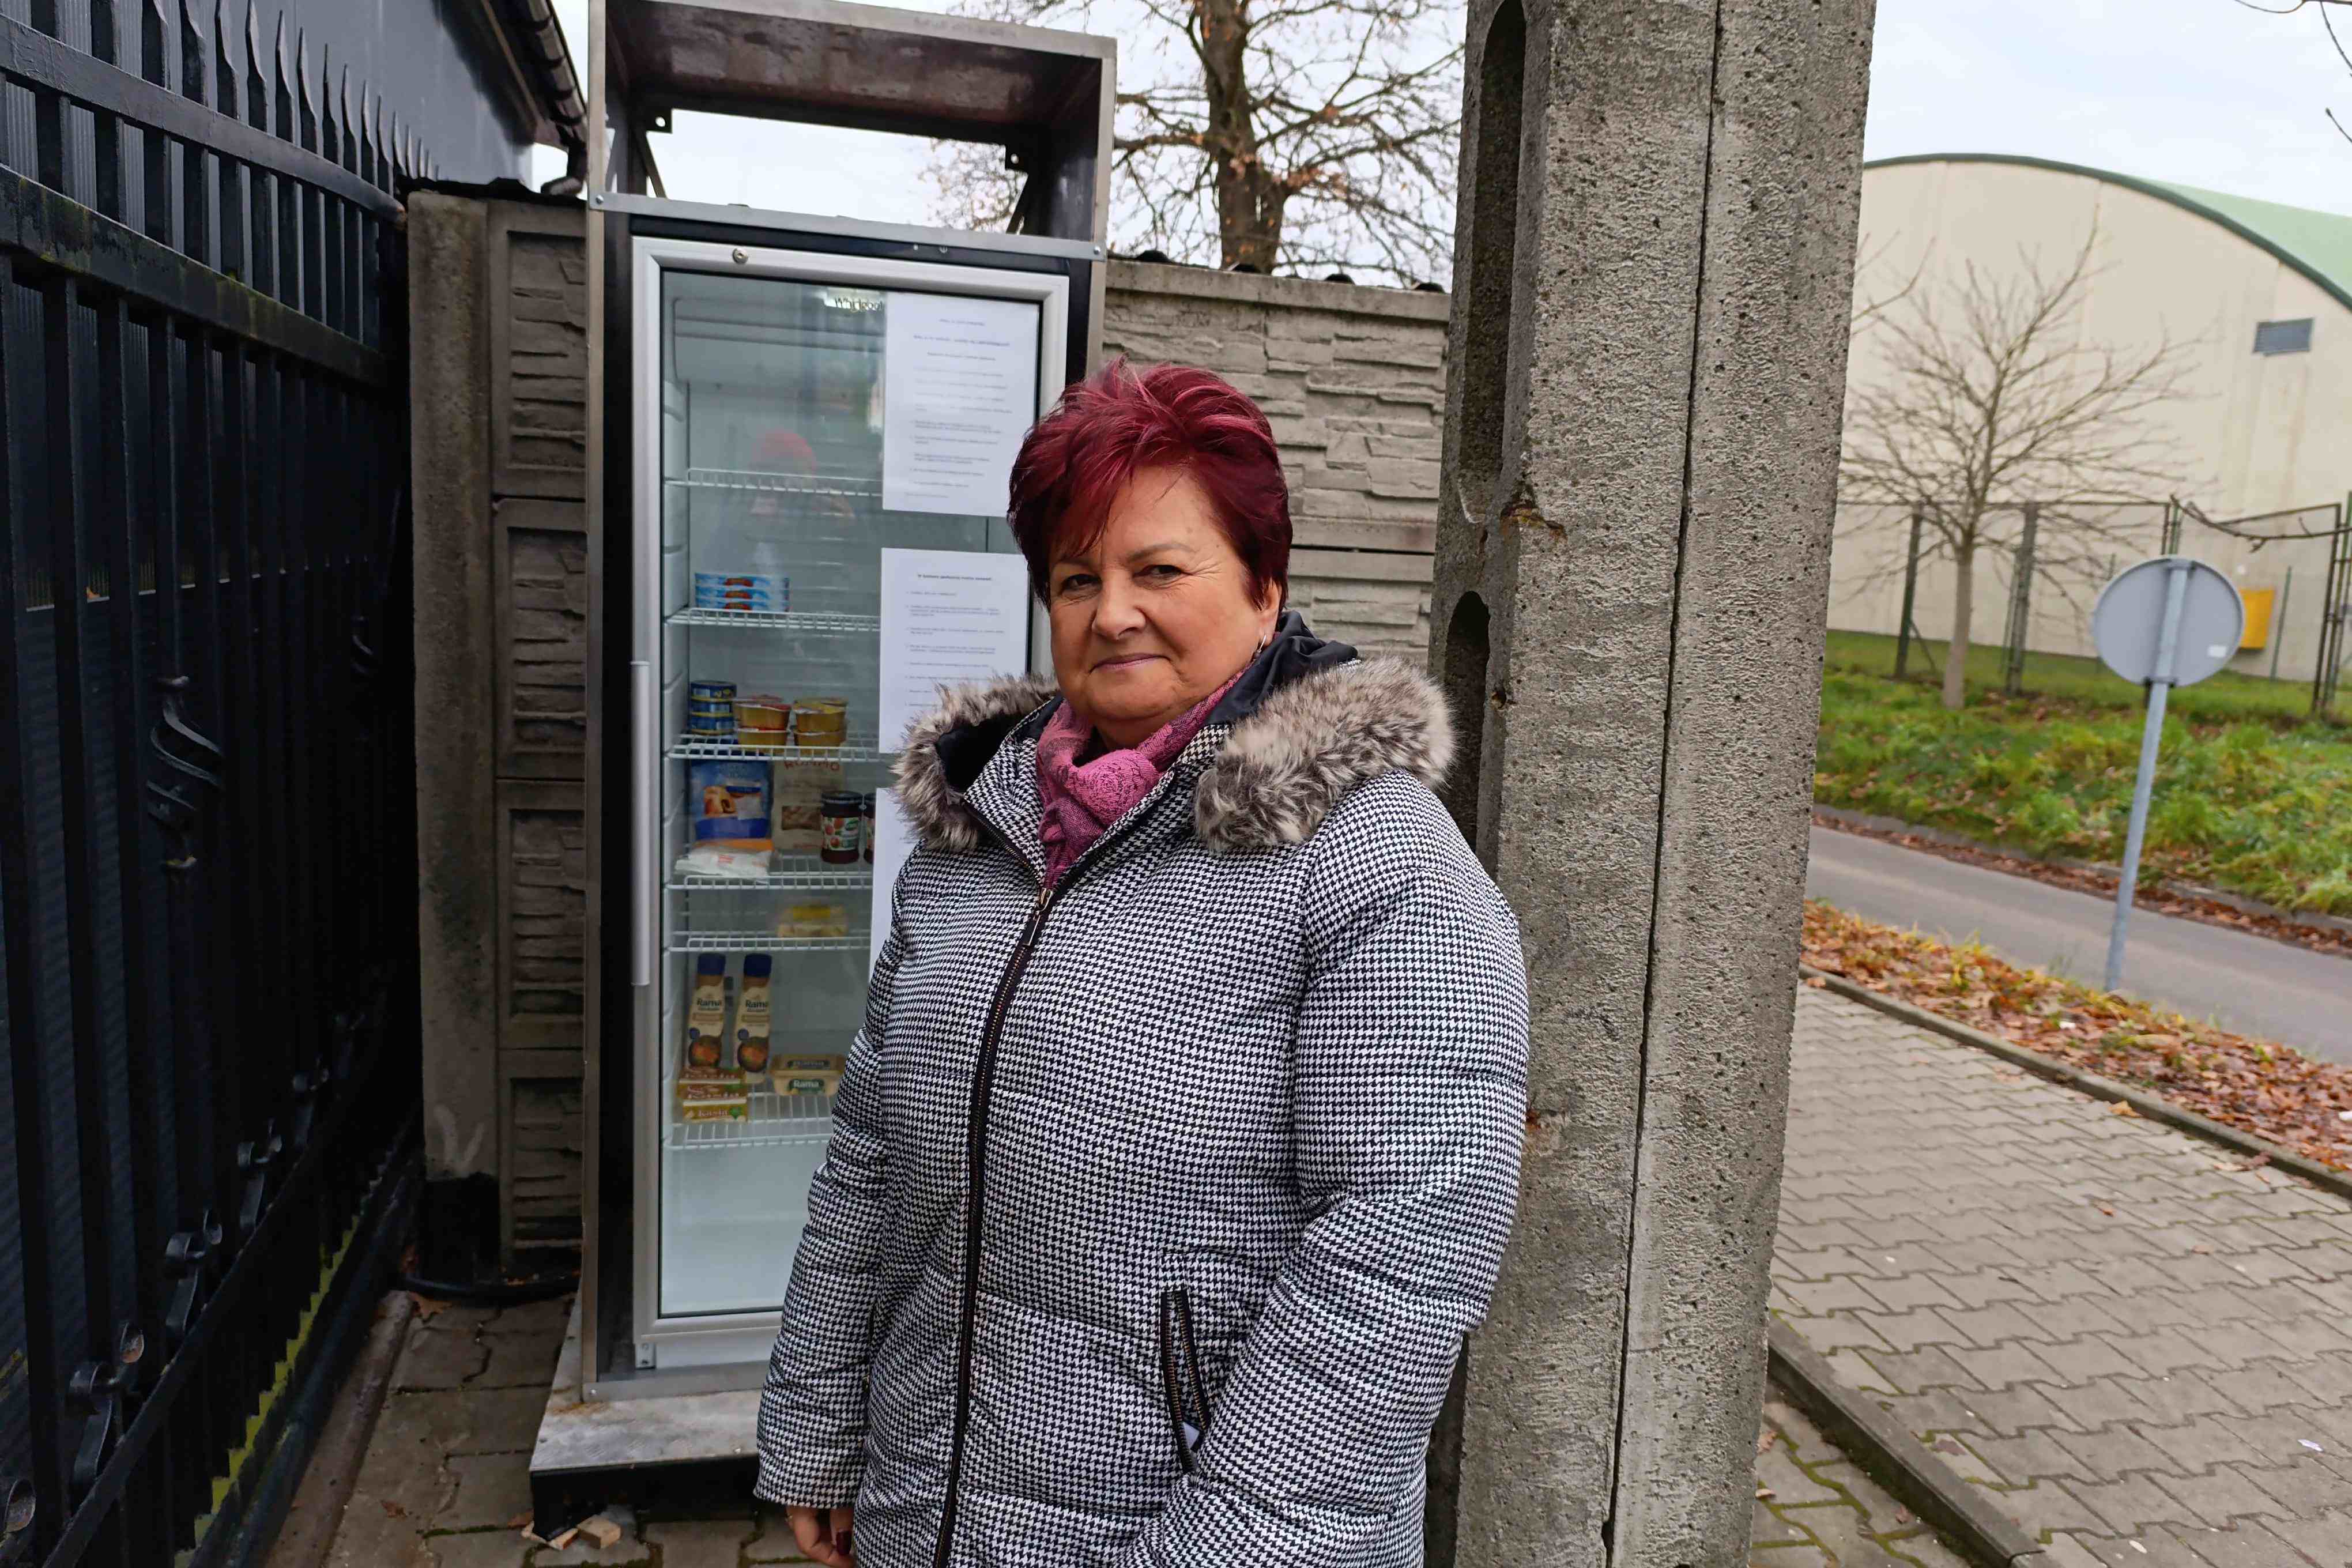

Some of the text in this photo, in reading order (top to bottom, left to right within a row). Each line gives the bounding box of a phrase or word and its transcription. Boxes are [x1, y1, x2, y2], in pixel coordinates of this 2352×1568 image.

[834, 295, 883, 311] Whirlpool
[745, 1000, 769, 1008] Rama
[793, 1080, 819, 1088] Rama
